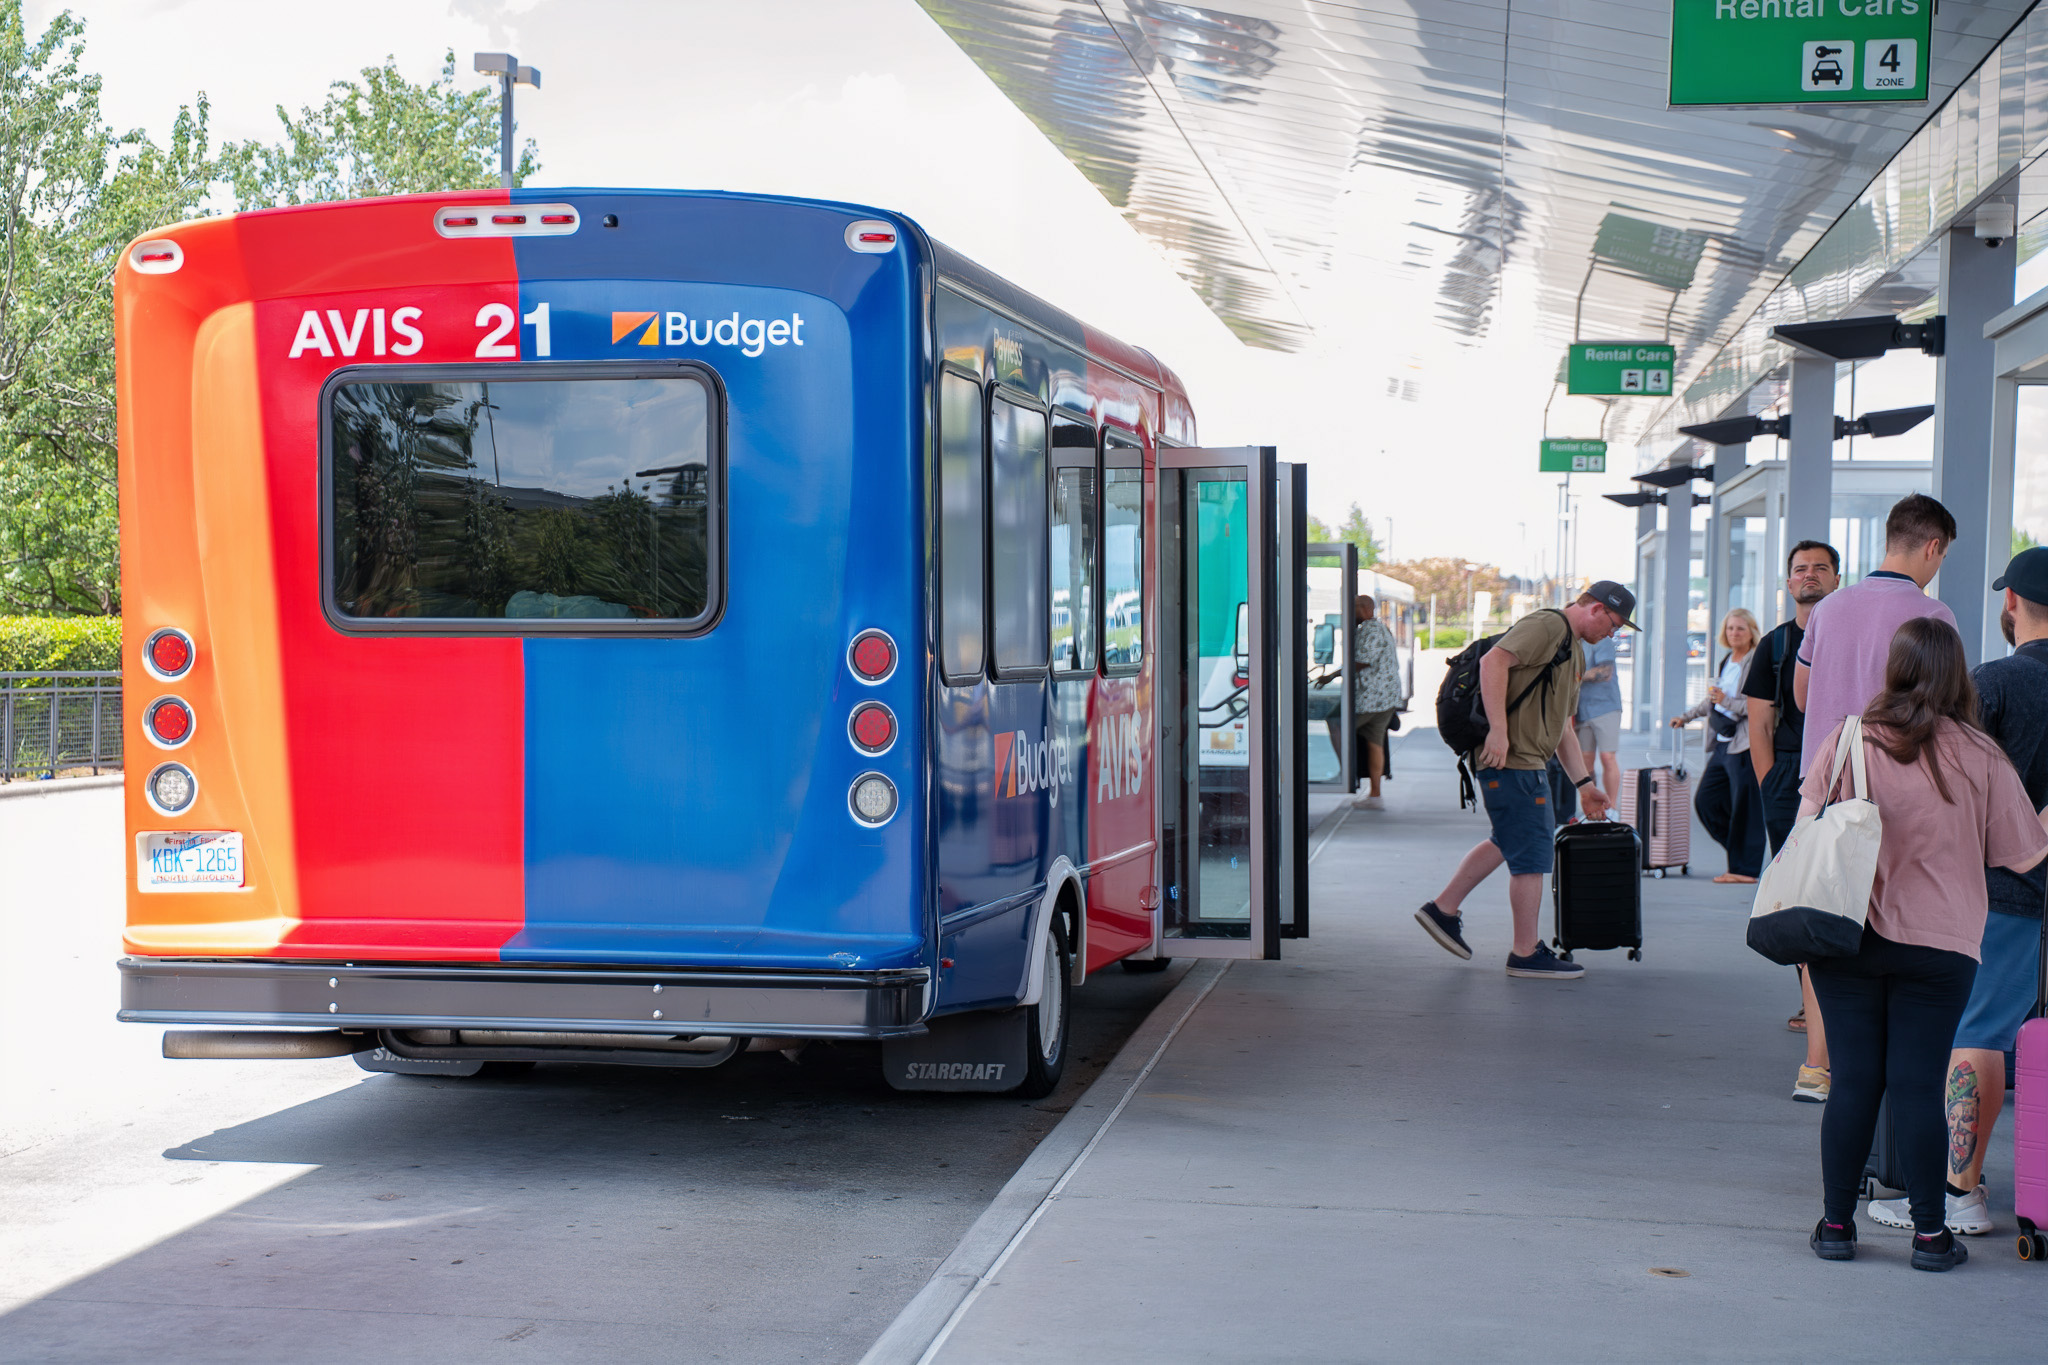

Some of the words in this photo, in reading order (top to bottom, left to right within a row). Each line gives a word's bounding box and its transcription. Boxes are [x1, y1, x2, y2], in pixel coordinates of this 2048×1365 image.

[1715, 0, 1824, 20] Rental
[1839, 0, 1919, 17] Cars
[1879, 44, 1901, 73] 4
[1875, 78, 1904, 87] ZONE
[288, 307, 424, 358] AVIS
[475, 302, 551, 358] 21
[665, 312, 804, 357] Budget
[993, 327, 1023, 370] Payless
[1585, 348, 1633, 361] Rental
[1635, 348, 1670, 362] Cars
[1653, 372, 1662, 384] 4
[1017, 724, 1072, 809] Budget
[1097, 710, 1142, 804] AVIS
[153, 848, 237, 873] KBK-1265
[156, 874, 188, 882] NORTH
[905, 1062, 1006, 1080] STARCRAFT
